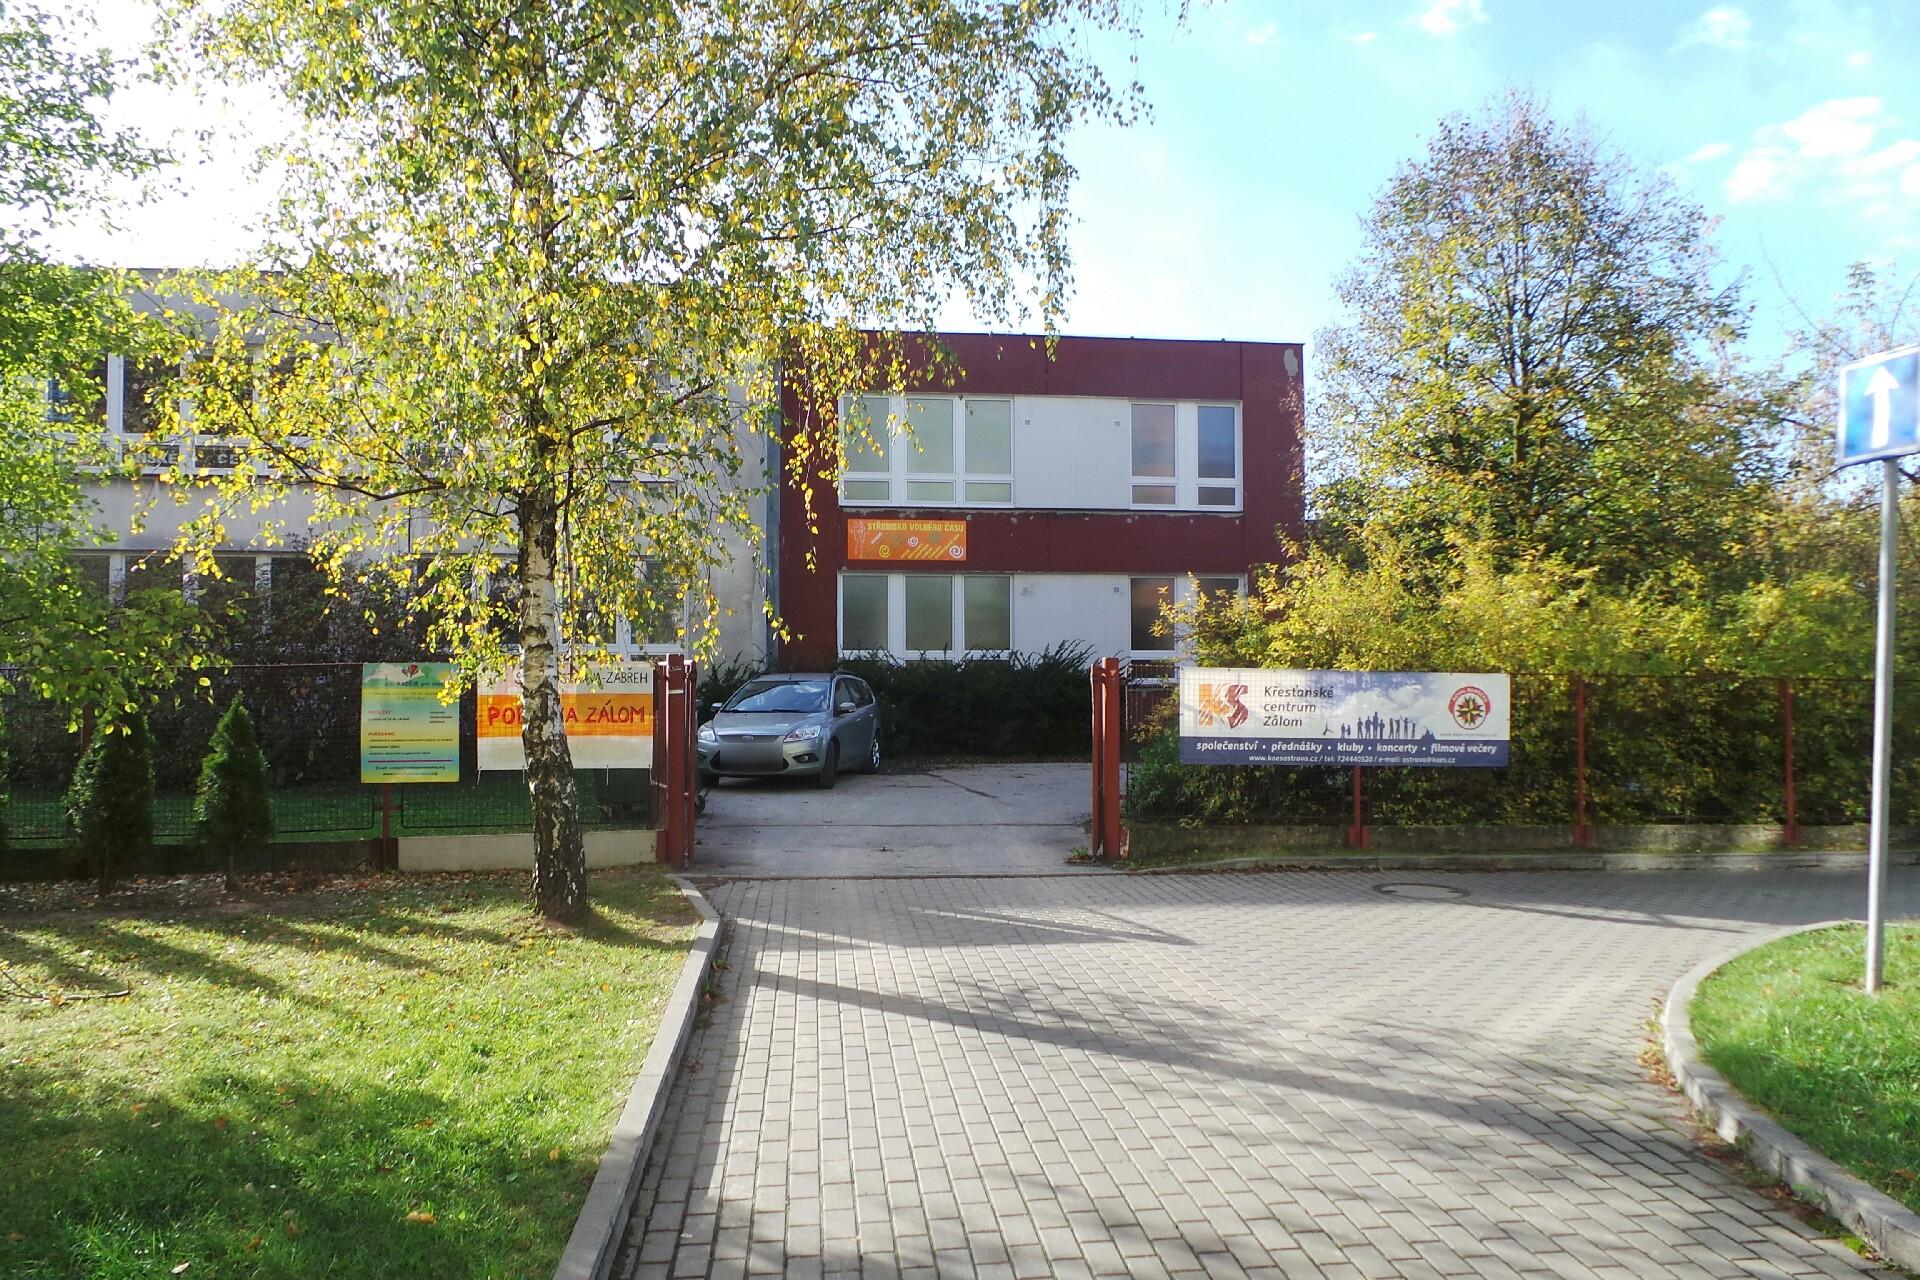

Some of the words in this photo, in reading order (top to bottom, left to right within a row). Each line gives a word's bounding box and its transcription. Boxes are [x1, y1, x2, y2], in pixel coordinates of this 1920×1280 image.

[1264, 684, 1334, 698] Křesťanské
[585, 699, 645, 724] ZÁLOM
[1263, 702, 1316, 712] centrum
[1263, 716, 1303, 727] Zálom
[1196, 740, 1259, 752] společenství
[1271, 741, 1323, 753] přednášky
[1337, 743, 1364, 753] kluby
[1377, 743, 1418, 754] koncerty
[1430, 743, 1465, 754] filmové
[1467, 743, 1497, 755] večery
